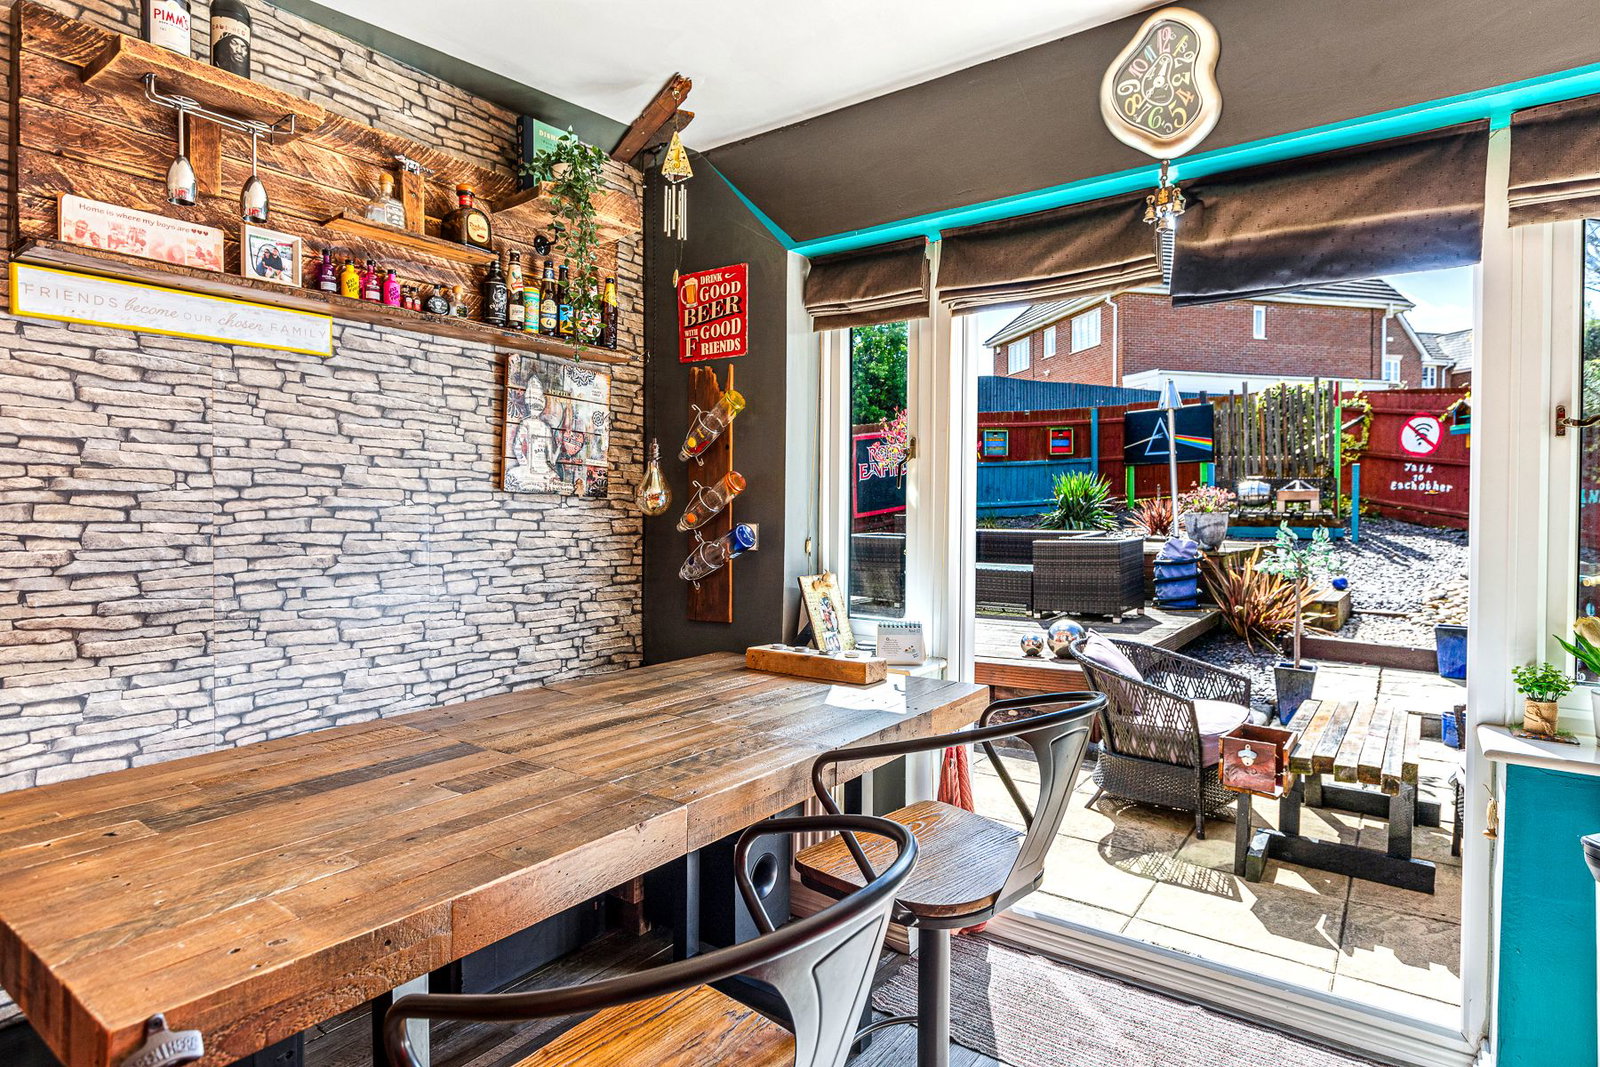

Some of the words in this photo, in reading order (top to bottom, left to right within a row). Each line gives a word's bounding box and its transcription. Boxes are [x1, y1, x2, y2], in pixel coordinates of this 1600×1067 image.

[153, 8, 190, 31] PIMM'S
[1129, 59, 1148, 79] 10
[1172, 72, 1190, 87] 3
[1125, 94, 1142, 116] 8
[1176, 88, 1194, 106] 4
[1148, 107, 1163, 129] 6
[1168, 100, 1187, 128] 5
[79, 203, 104, 214] Home
[106, 208, 114, 216] is
[116, 211, 141, 223] where
[142, 217, 155, 227] my
[156, 220, 176, 232] boys
[177, 225, 190, 233] are
[700, 272, 723, 285] DRINK
[699, 281, 741, 302] GOOD
[23, 282, 118, 308] FRIENDS
[124, 296, 178, 319] become
[183, 311, 212, 324] OUR
[270, 322, 327, 340] FAMILY
[684, 295, 740, 328] BEER
[684, 329, 698, 337] WITH
[700, 317, 742, 340] GOOD
[684, 336, 741, 357] FRIENDS
